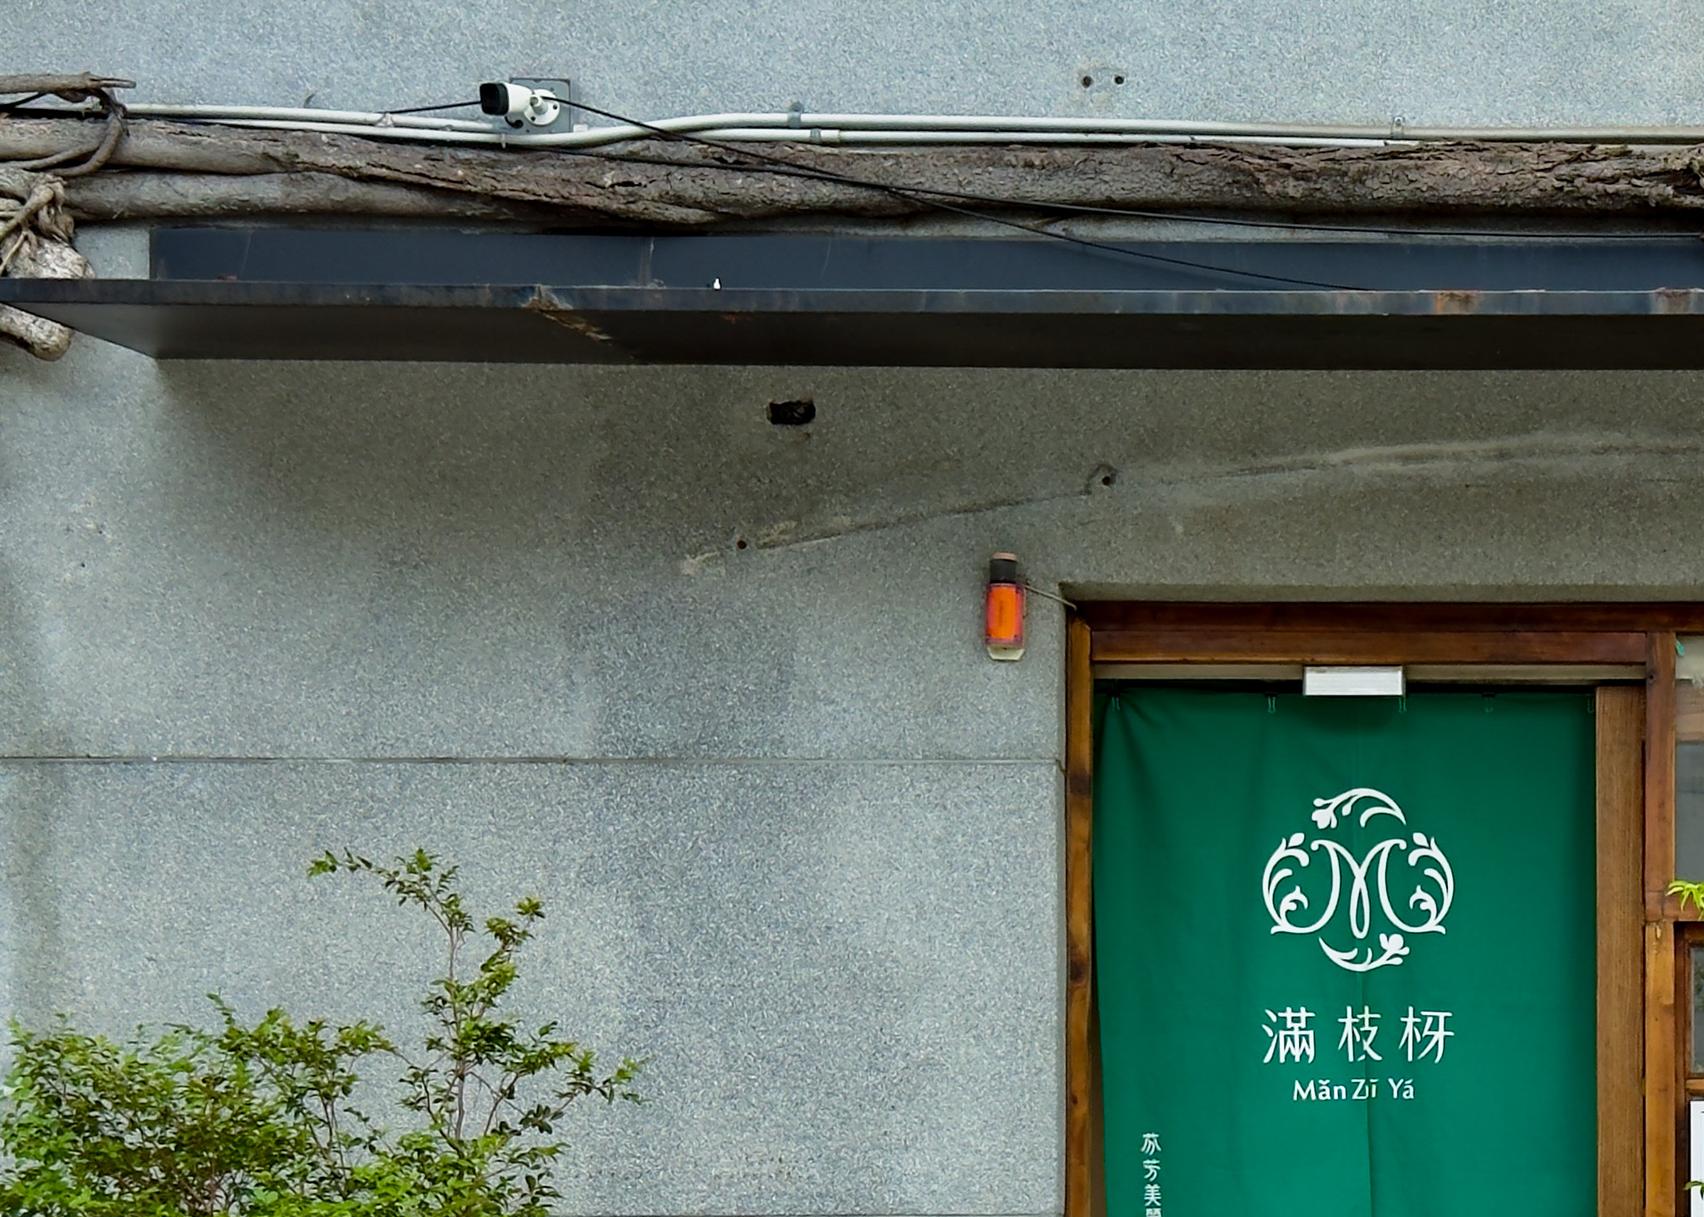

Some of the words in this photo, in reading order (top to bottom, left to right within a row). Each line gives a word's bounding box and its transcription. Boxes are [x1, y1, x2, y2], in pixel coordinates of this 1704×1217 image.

[1261, 1005, 1455, 1064] 滿枝枒
[1388, 1078, 1415, 1100] Yá
